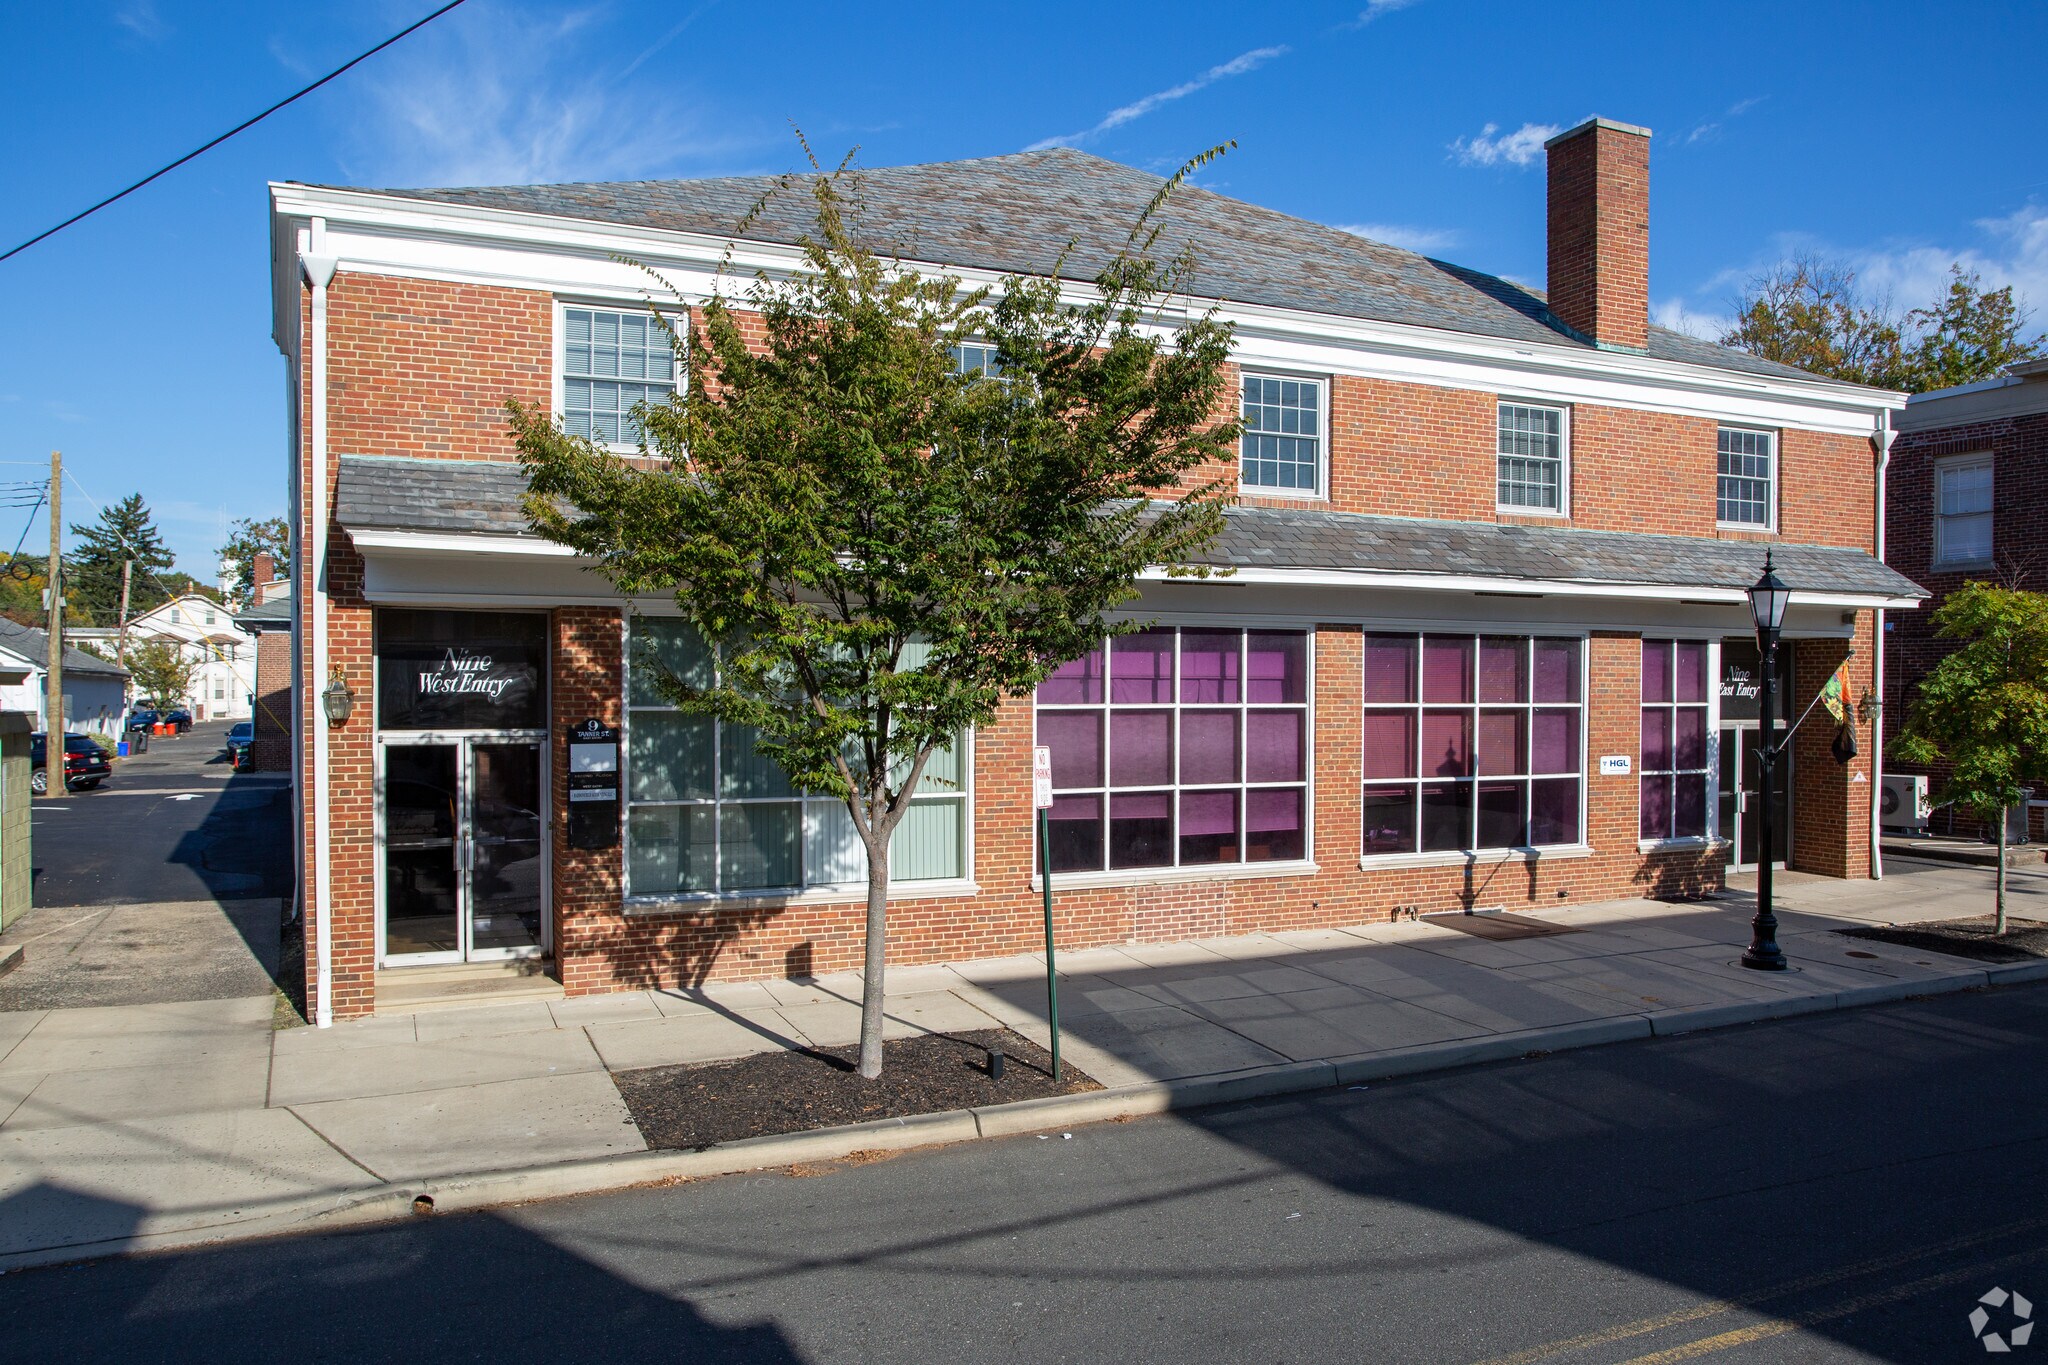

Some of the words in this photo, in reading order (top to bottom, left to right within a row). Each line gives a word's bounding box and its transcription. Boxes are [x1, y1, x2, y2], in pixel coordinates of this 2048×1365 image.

[440, 647, 492, 671] Nine
[1726, 665, 1751, 682] Nine
[419, 672, 461, 693] West
[457, 673, 513, 697] Entry
[1719, 682, 1735, 696] East
[1736, 682, 1761, 699] Entry
[588, 720, 599, 731] 9
[1039, 753, 1046, 765] NO
[1609, 759, 1629, 767] HGL
[1035, 768, 1050, 779] PARKING
